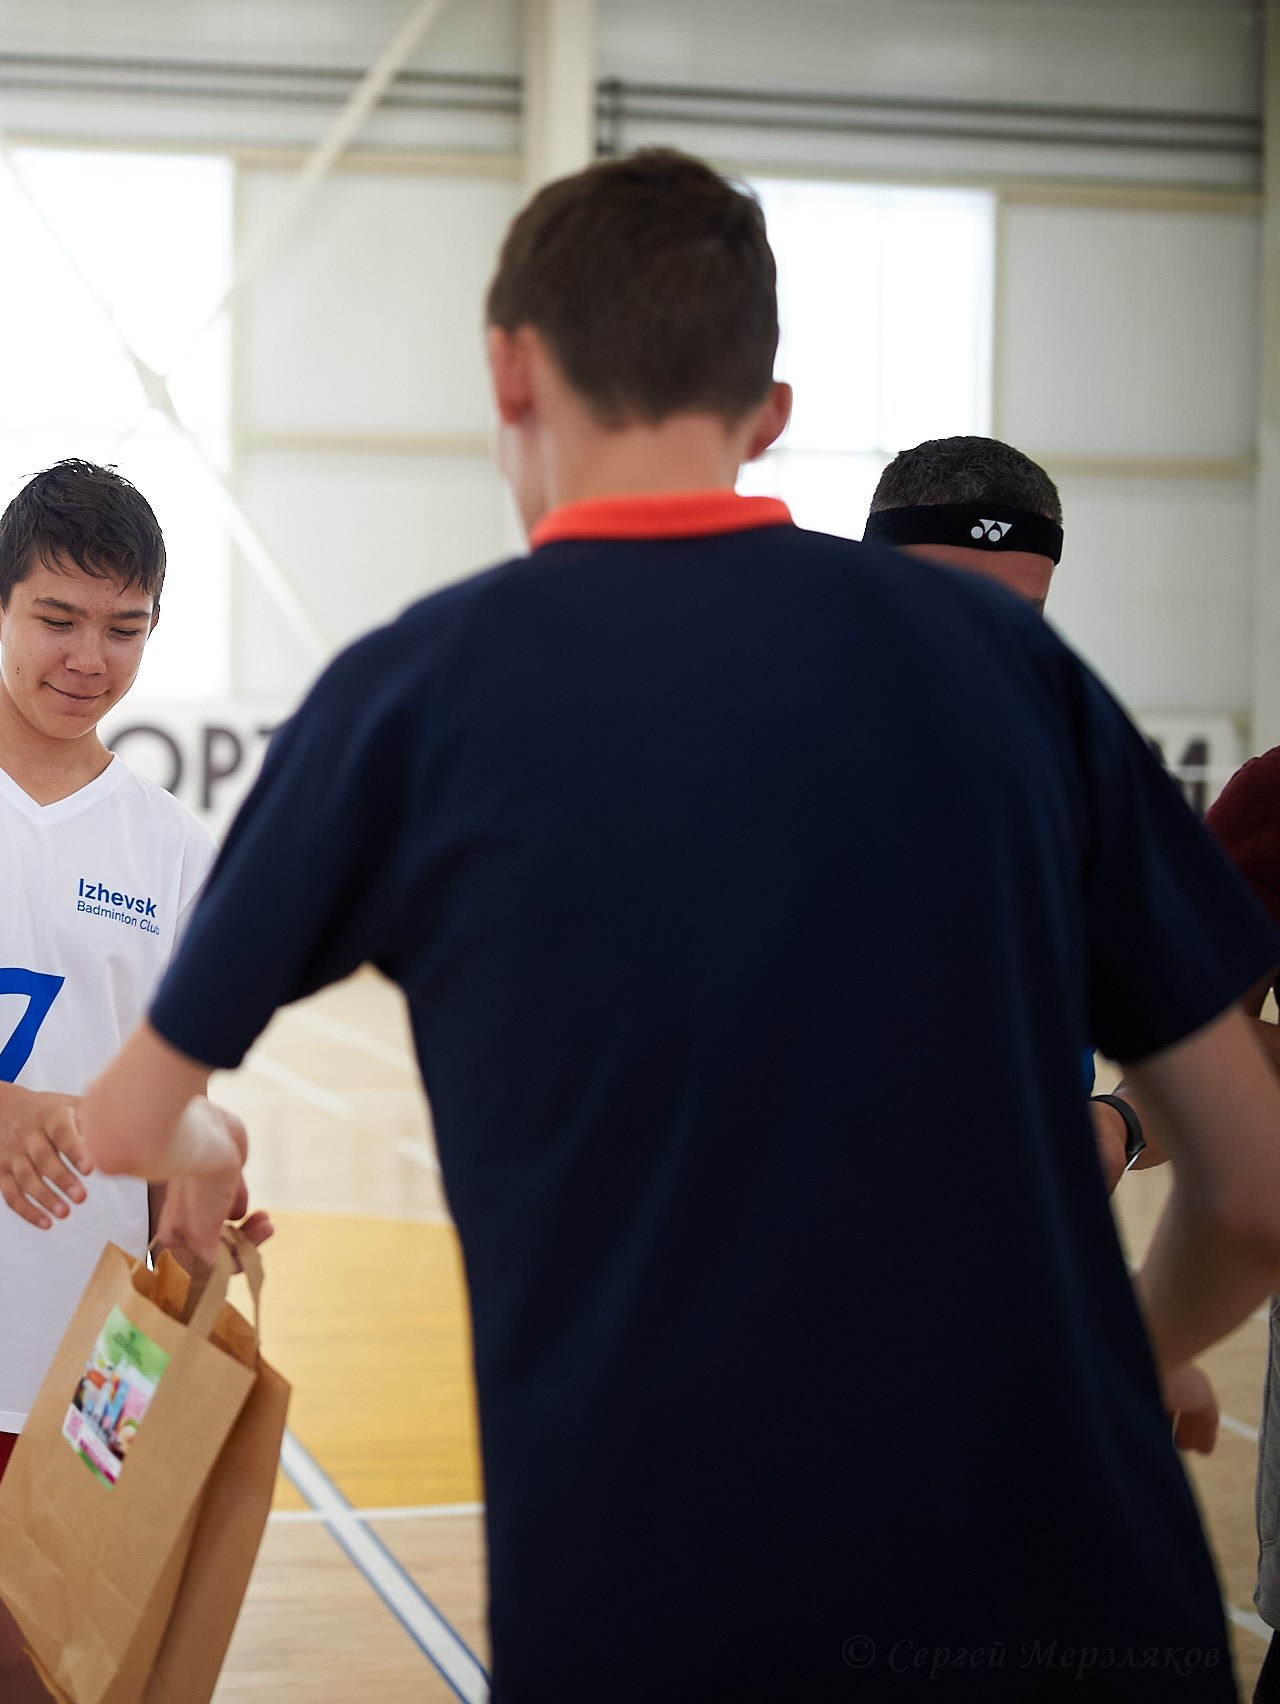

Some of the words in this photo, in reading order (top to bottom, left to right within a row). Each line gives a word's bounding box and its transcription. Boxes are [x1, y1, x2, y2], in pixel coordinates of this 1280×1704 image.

[107, 724, 276, 811] ОР
[77, 900, 137, 927] Badminton
[78, 878, 157, 918] Izhevsk
